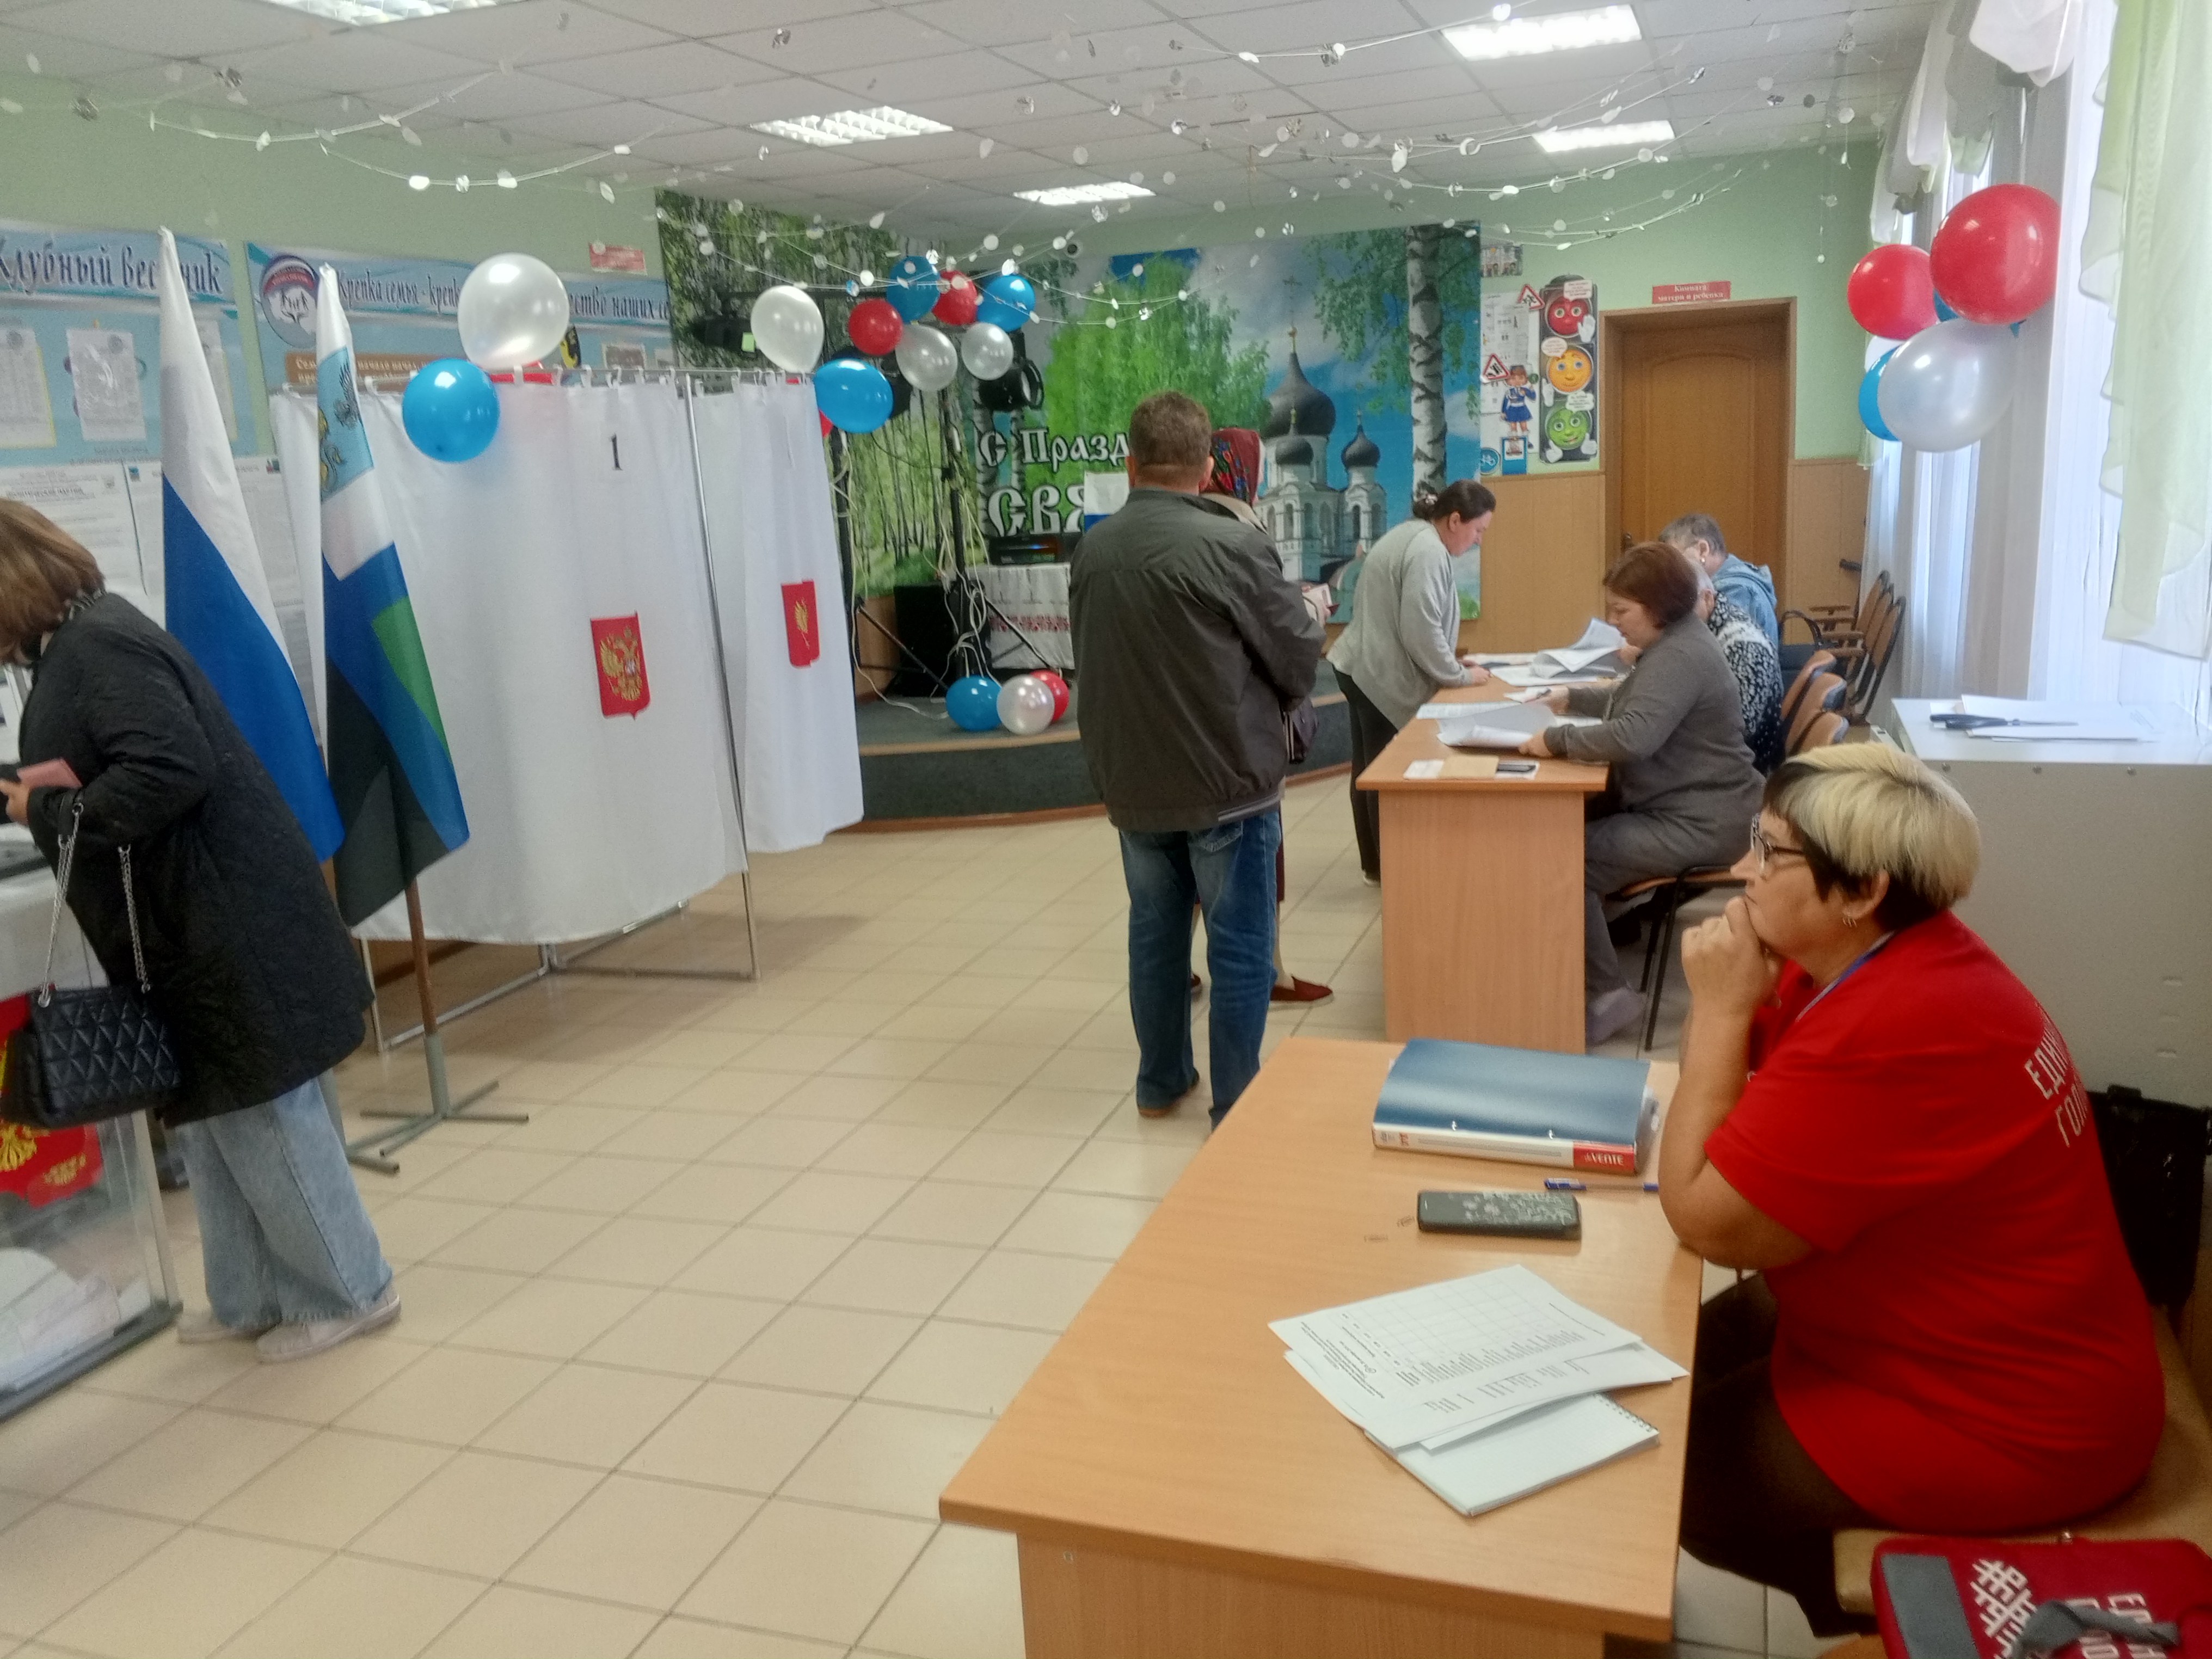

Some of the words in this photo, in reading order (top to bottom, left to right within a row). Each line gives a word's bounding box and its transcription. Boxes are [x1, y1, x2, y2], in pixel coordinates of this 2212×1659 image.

[121, 244, 225, 294] весник
[427, 274, 461, 315] крепк
[1019, 427, 1130, 472] Празд
[988, 484, 1085, 537] СВЯ
